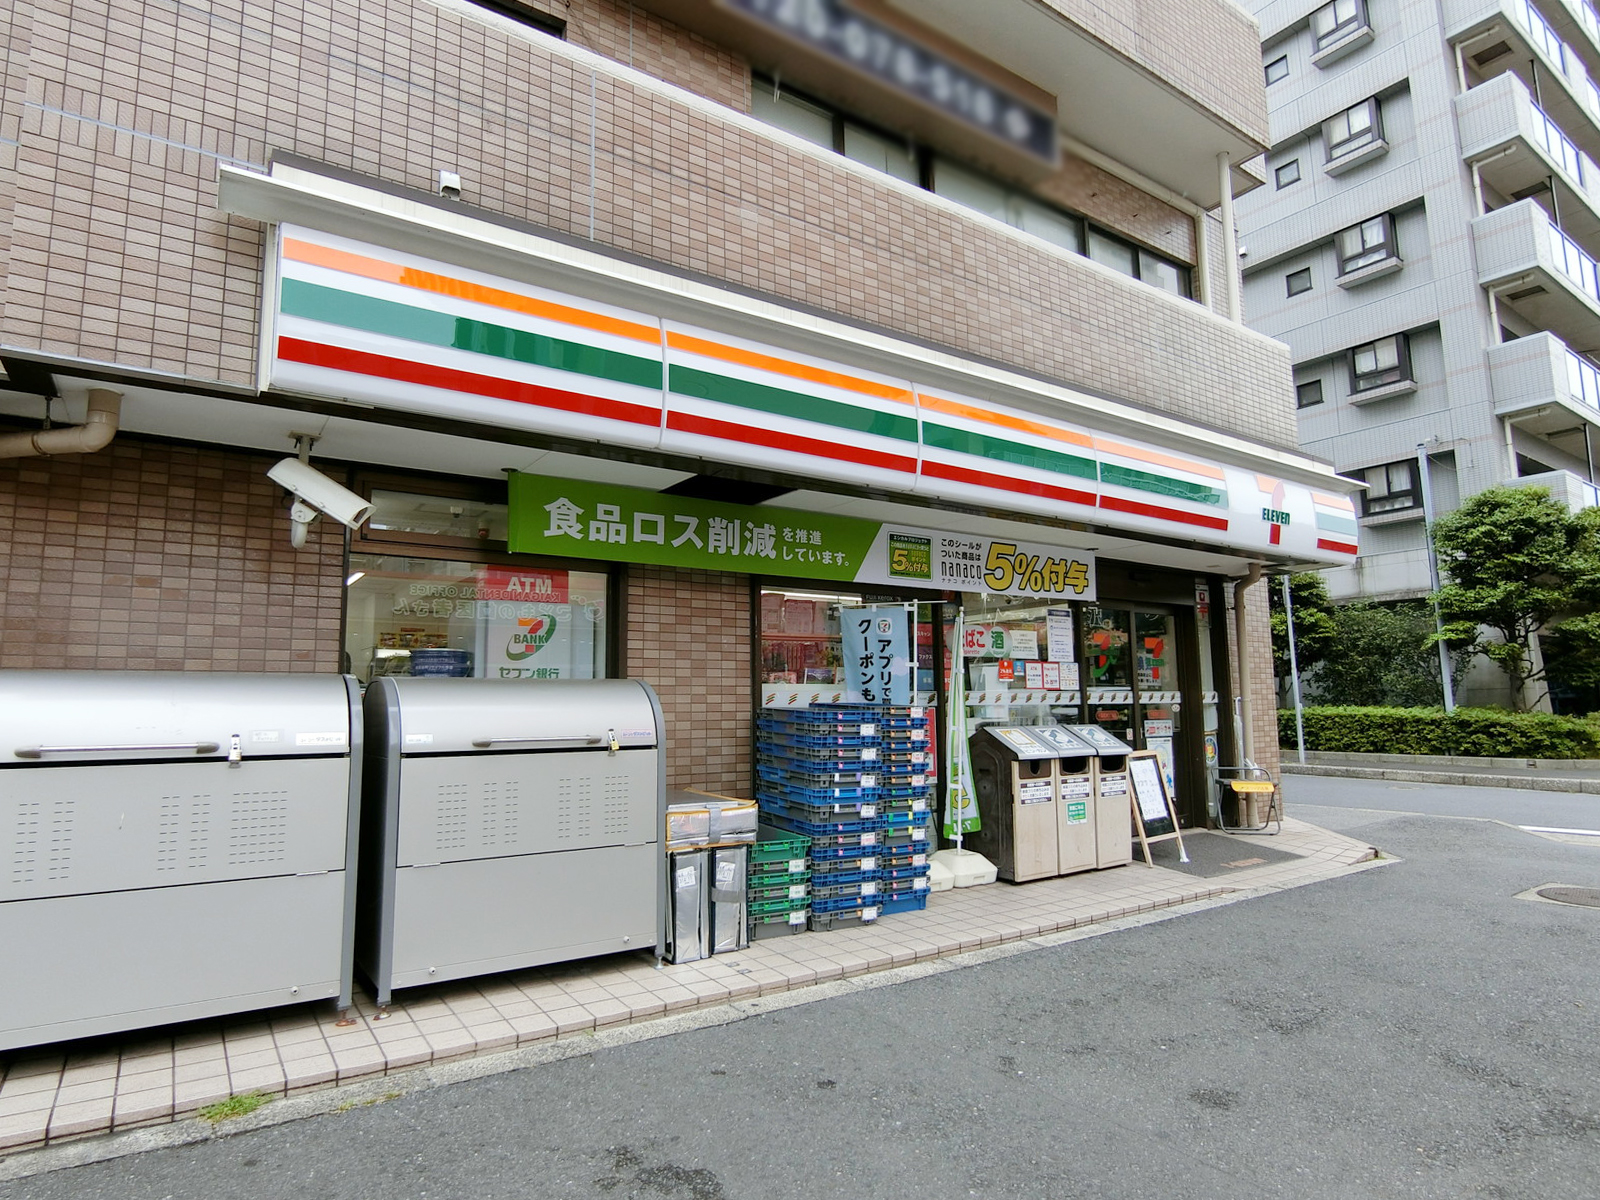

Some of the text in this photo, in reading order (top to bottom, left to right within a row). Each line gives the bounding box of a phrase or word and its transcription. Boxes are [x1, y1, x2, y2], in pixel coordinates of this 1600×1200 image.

[543, 497, 778, 560] 食品ロス削減
[782, 527, 822, 546] を推進
[941, 538, 982, 551] このシールが
[782, 545, 851, 568] しています。
[891, 548, 929, 574] 5%付与
[941, 550, 982, 562] ついた商品は
[941, 561, 982, 580] nanaco
[983, 541, 1090, 594] 5%付与
[506, 576, 552, 595] ATM
[513, 633, 547, 645] BANK
[963, 629, 986, 648] ばこ
[990, 630, 1005, 649] 酒
[858, 619, 876, 702] クーポンも
